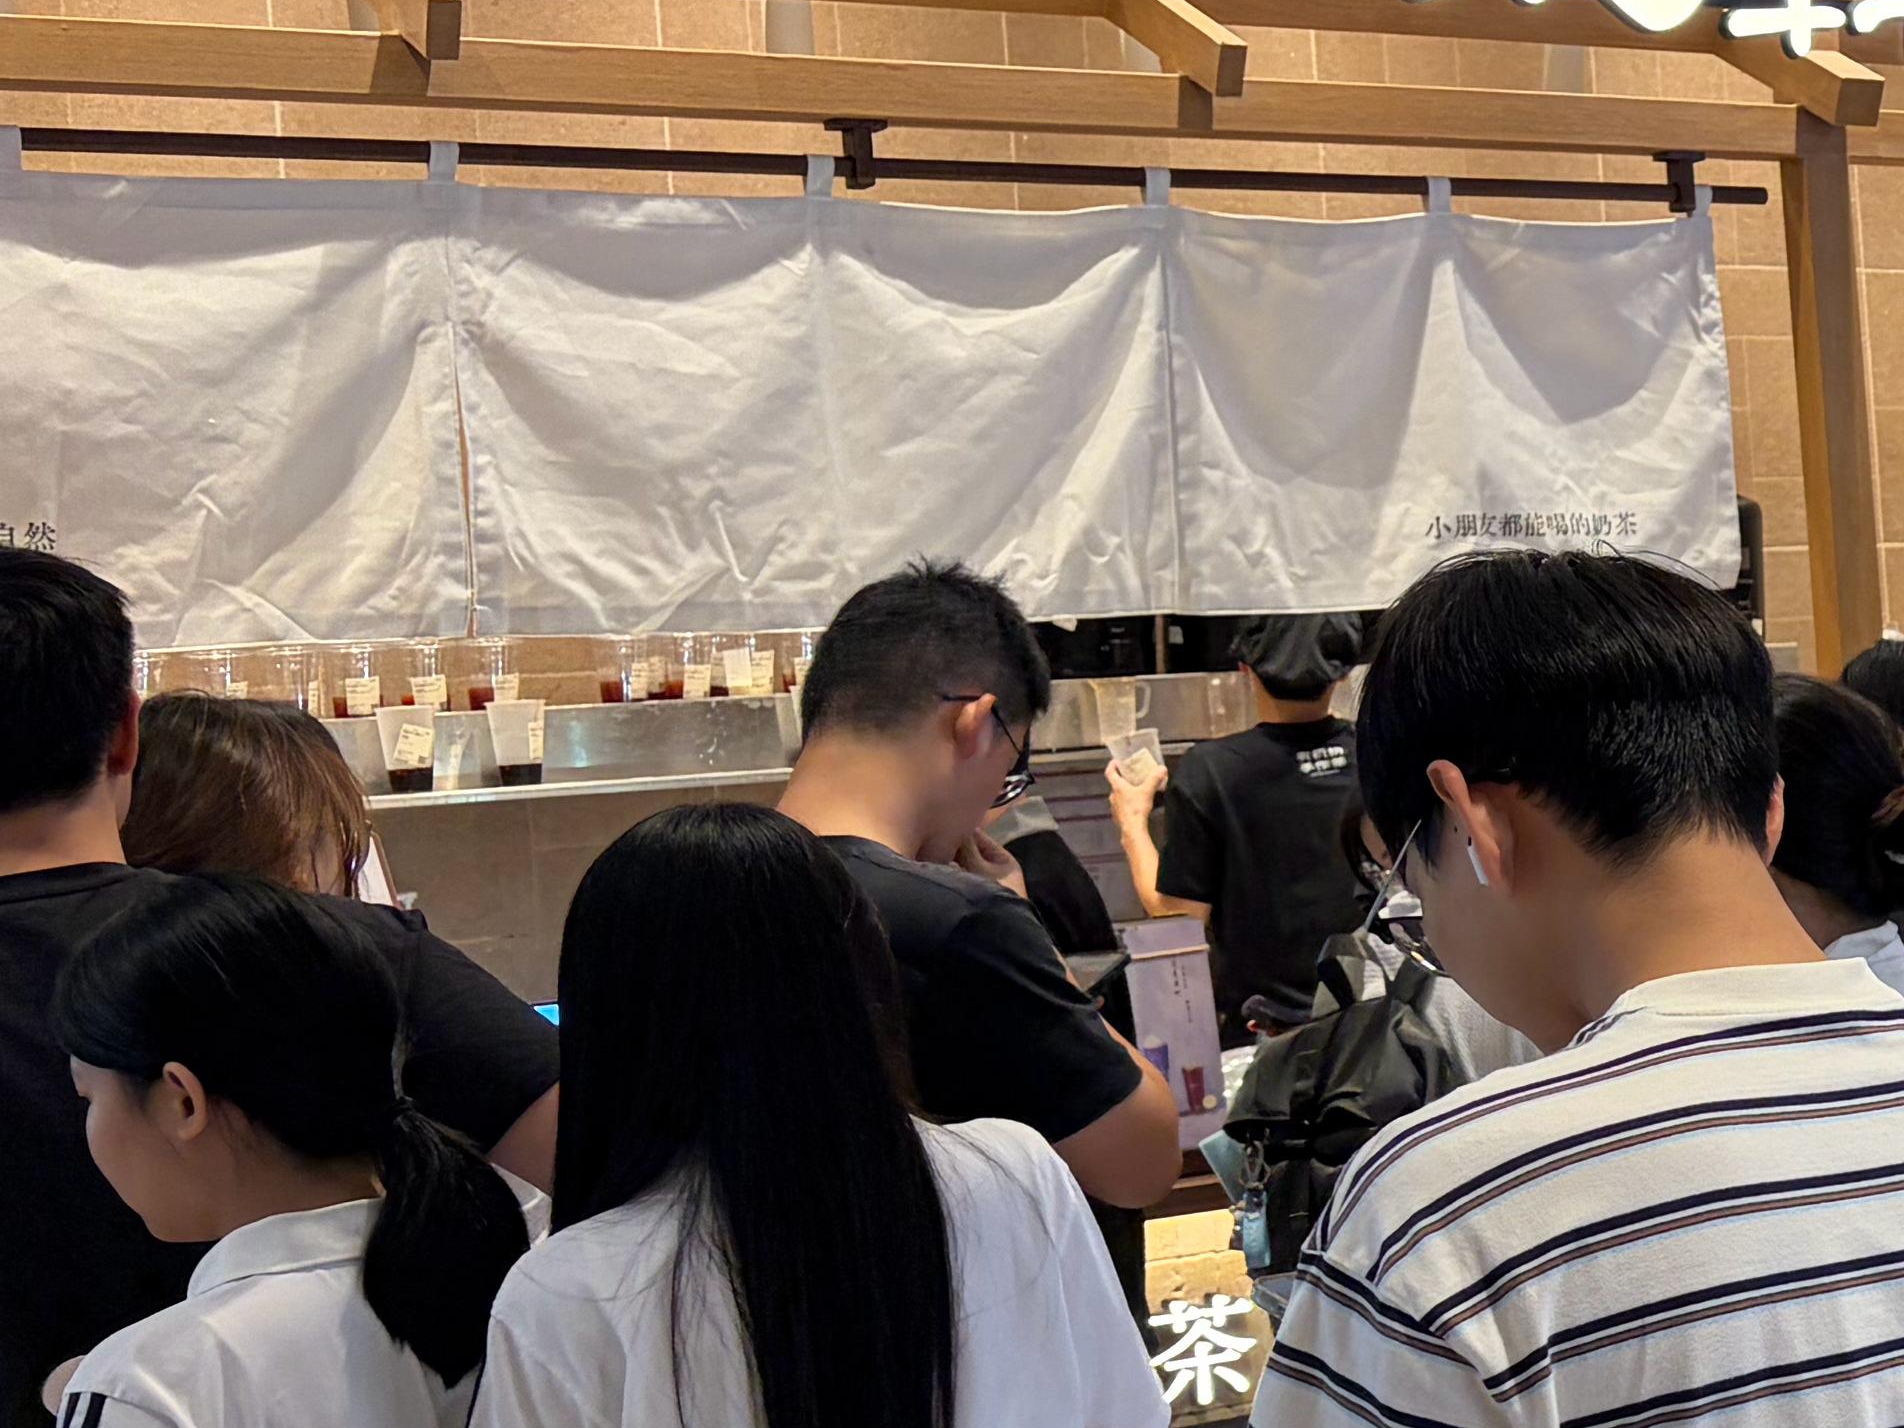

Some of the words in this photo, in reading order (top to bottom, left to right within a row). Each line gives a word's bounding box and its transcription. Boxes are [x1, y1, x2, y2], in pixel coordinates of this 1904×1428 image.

[1425, 511, 1637, 540] 小朋友都能喝的奶茶
[1148, 1294, 1257, 1405] 茶
